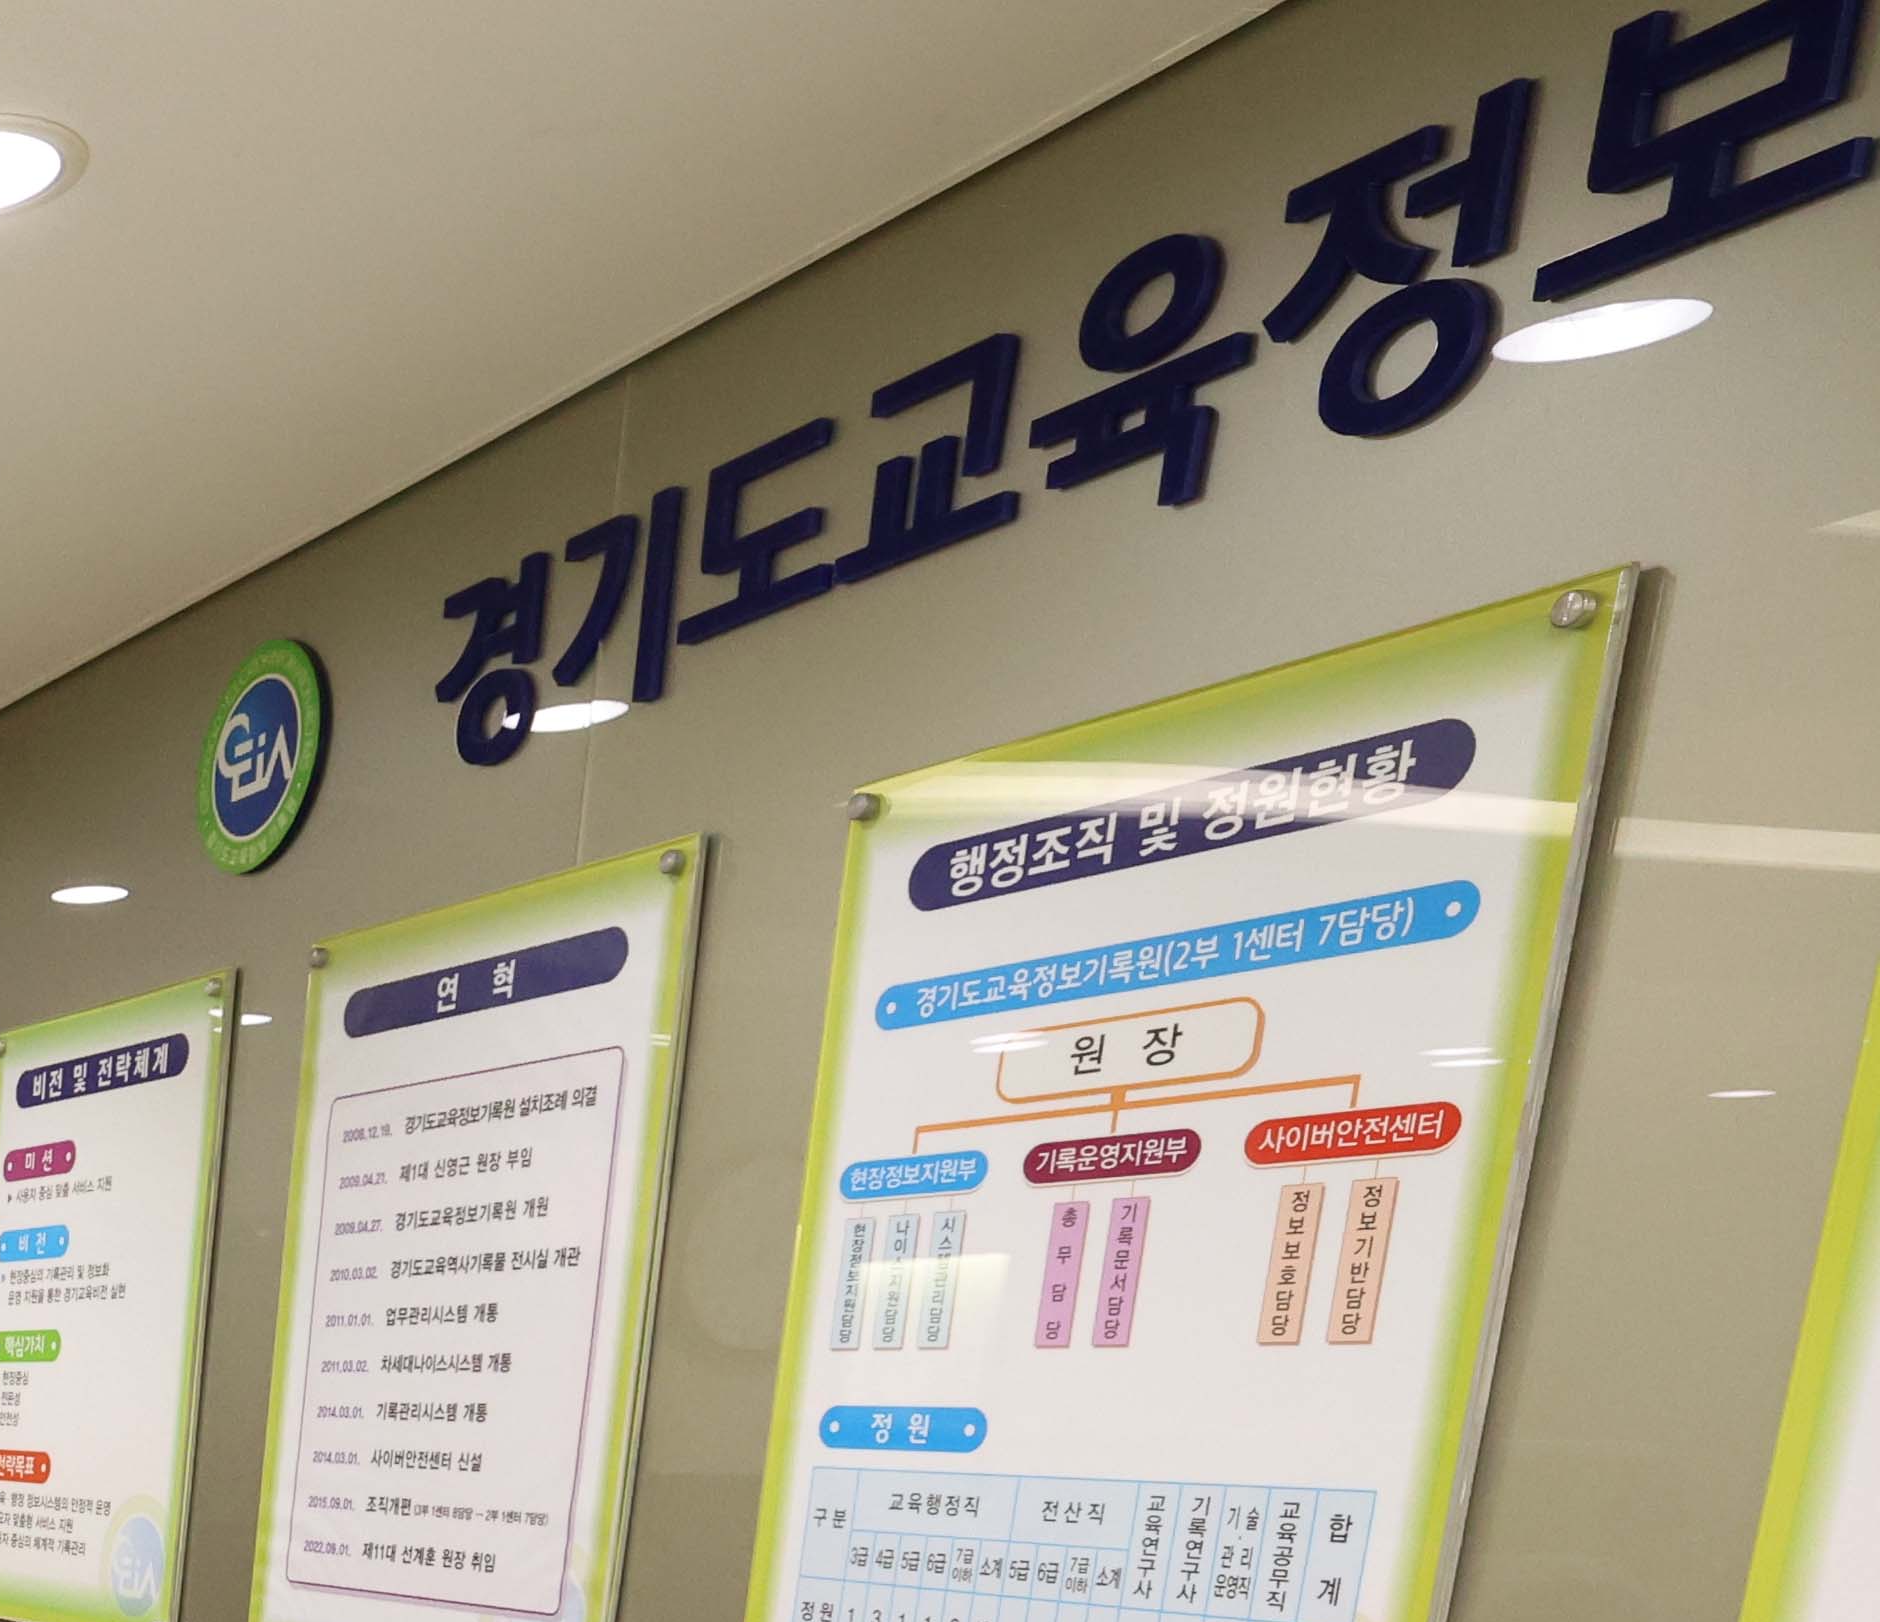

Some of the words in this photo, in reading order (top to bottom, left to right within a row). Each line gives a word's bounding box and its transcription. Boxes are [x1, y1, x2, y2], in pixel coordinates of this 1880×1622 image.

[434, 0, 1878, 766] 경기도교육정보
[949, 811, 1118, 898] 행정조직
[1138, 804, 1181, 855] 및
[1202, 739, 1416, 836] 정원현황
[1233, 919, 1304, 960] 1센터
[1320, 896, 1415, 946] 7담당)
[32, 1068, 63, 1100] 비전
[73, 1062, 87, 1092] 및
[97, 1043, 168, 1087] 전략체계
[404, 1101, 516, 1135] 경기도교육정보기록원
[519, 1091, 568, 1116] 설치조례
[572, 1085, 598, 1108] 의결
[1257, 1109, 1444, 1153] 사이버안전센터
[399, 1164, 428, 1182] 제1대
[435, 1156, 470, 1179] 신영근
[476, 1152, 501, 1174] 원장
[507, 1147, 533, 1169] 부임
[1035, 1137, 1188, 1174] 기록운영지원부
[849, 1156, 976, 1191] 현장정보지원부
[395, 1200, 517, 1231] 경기도교육정보기록원
[523, 1197, 549, 1218] 개원
[390, 1252, 506, 1279] 경기도교육역사기록물
[511, 1248, 549, 1271] 전시실
[553, 1247, 581, 1267] 개관
[1102, 1203, 1138, 1340] 기록문서담당
[1271, 1189, 1311, 1338] 정보보호담당
[1340, 1184, 1383, 1337] 정보기반담당
[386, 1304, 467, 1326] 업무관리시스템
[473, 1303, 499, 1323] 개통
[5, 1335, 45, 1358] 핵심가치
[380, 1353, 483, 1373] 차세대나이스시스템
[487, 1353, 512, 1373] 개통
[376, 1402, 458, 1422] 기록관리시스템
[463, 1403, 488, 1423] 개통
[371, 1450, 452, 1471] 사이버안전센터
[457, 1452, 482, 1472] 신설
[365, 1496, 412, 1516] 조직개편
[888, 1493, 980, 1518] 교육행정직
[362, 1541, 397, 1562] 제11대
[441, 1549, 466, 1570] 원장
[471, 1552, 496, 1573] 취임
[900, 1550, 921, 1572] 5급
[927, 1552, 947, 1575] 6급
[955, 1547, 974, 1565] 7급
[1008, 1558, 1030, 1582] 5급
[1037, 1560, 1059, 1585] 6급
[1070, 1557, 1090, 1575] 7급
